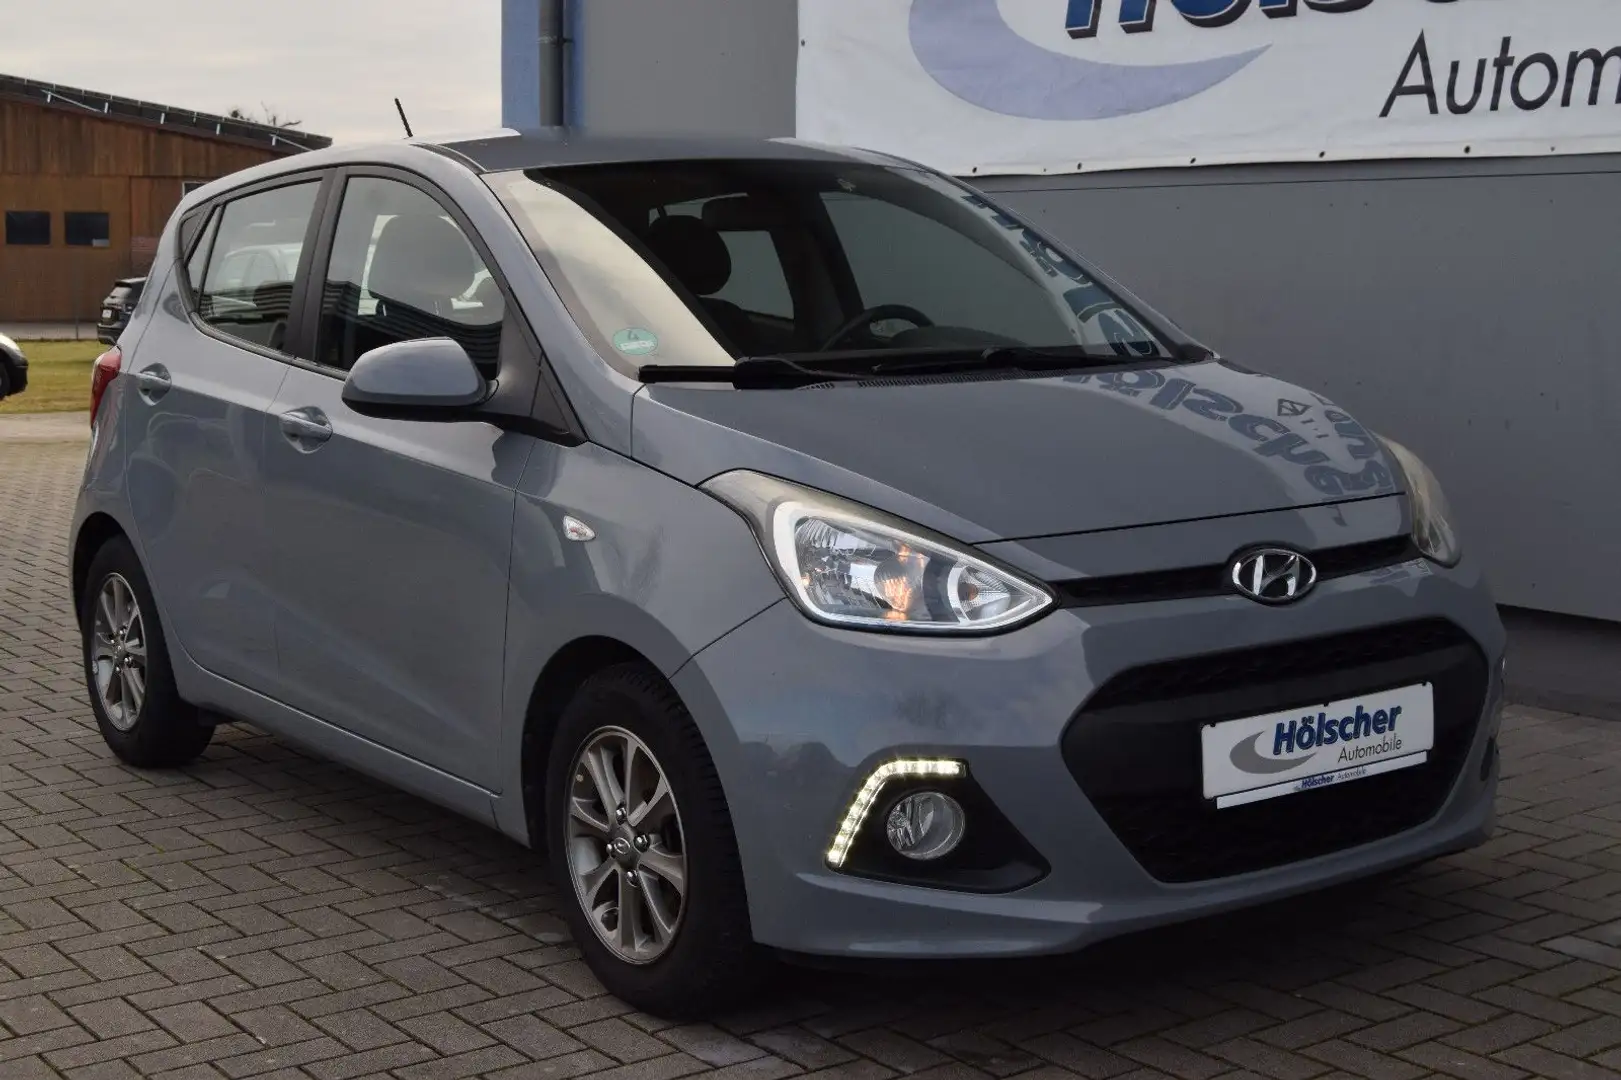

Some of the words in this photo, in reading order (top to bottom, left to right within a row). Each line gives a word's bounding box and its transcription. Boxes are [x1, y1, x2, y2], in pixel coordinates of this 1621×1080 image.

[1378, 29, 1621, 118] Autom
[1273, 705, 1402, 755] Hölscher
[1338, 734, 1402, 763] Automobile
[1302, 775, 1335, 788] Hölscher
